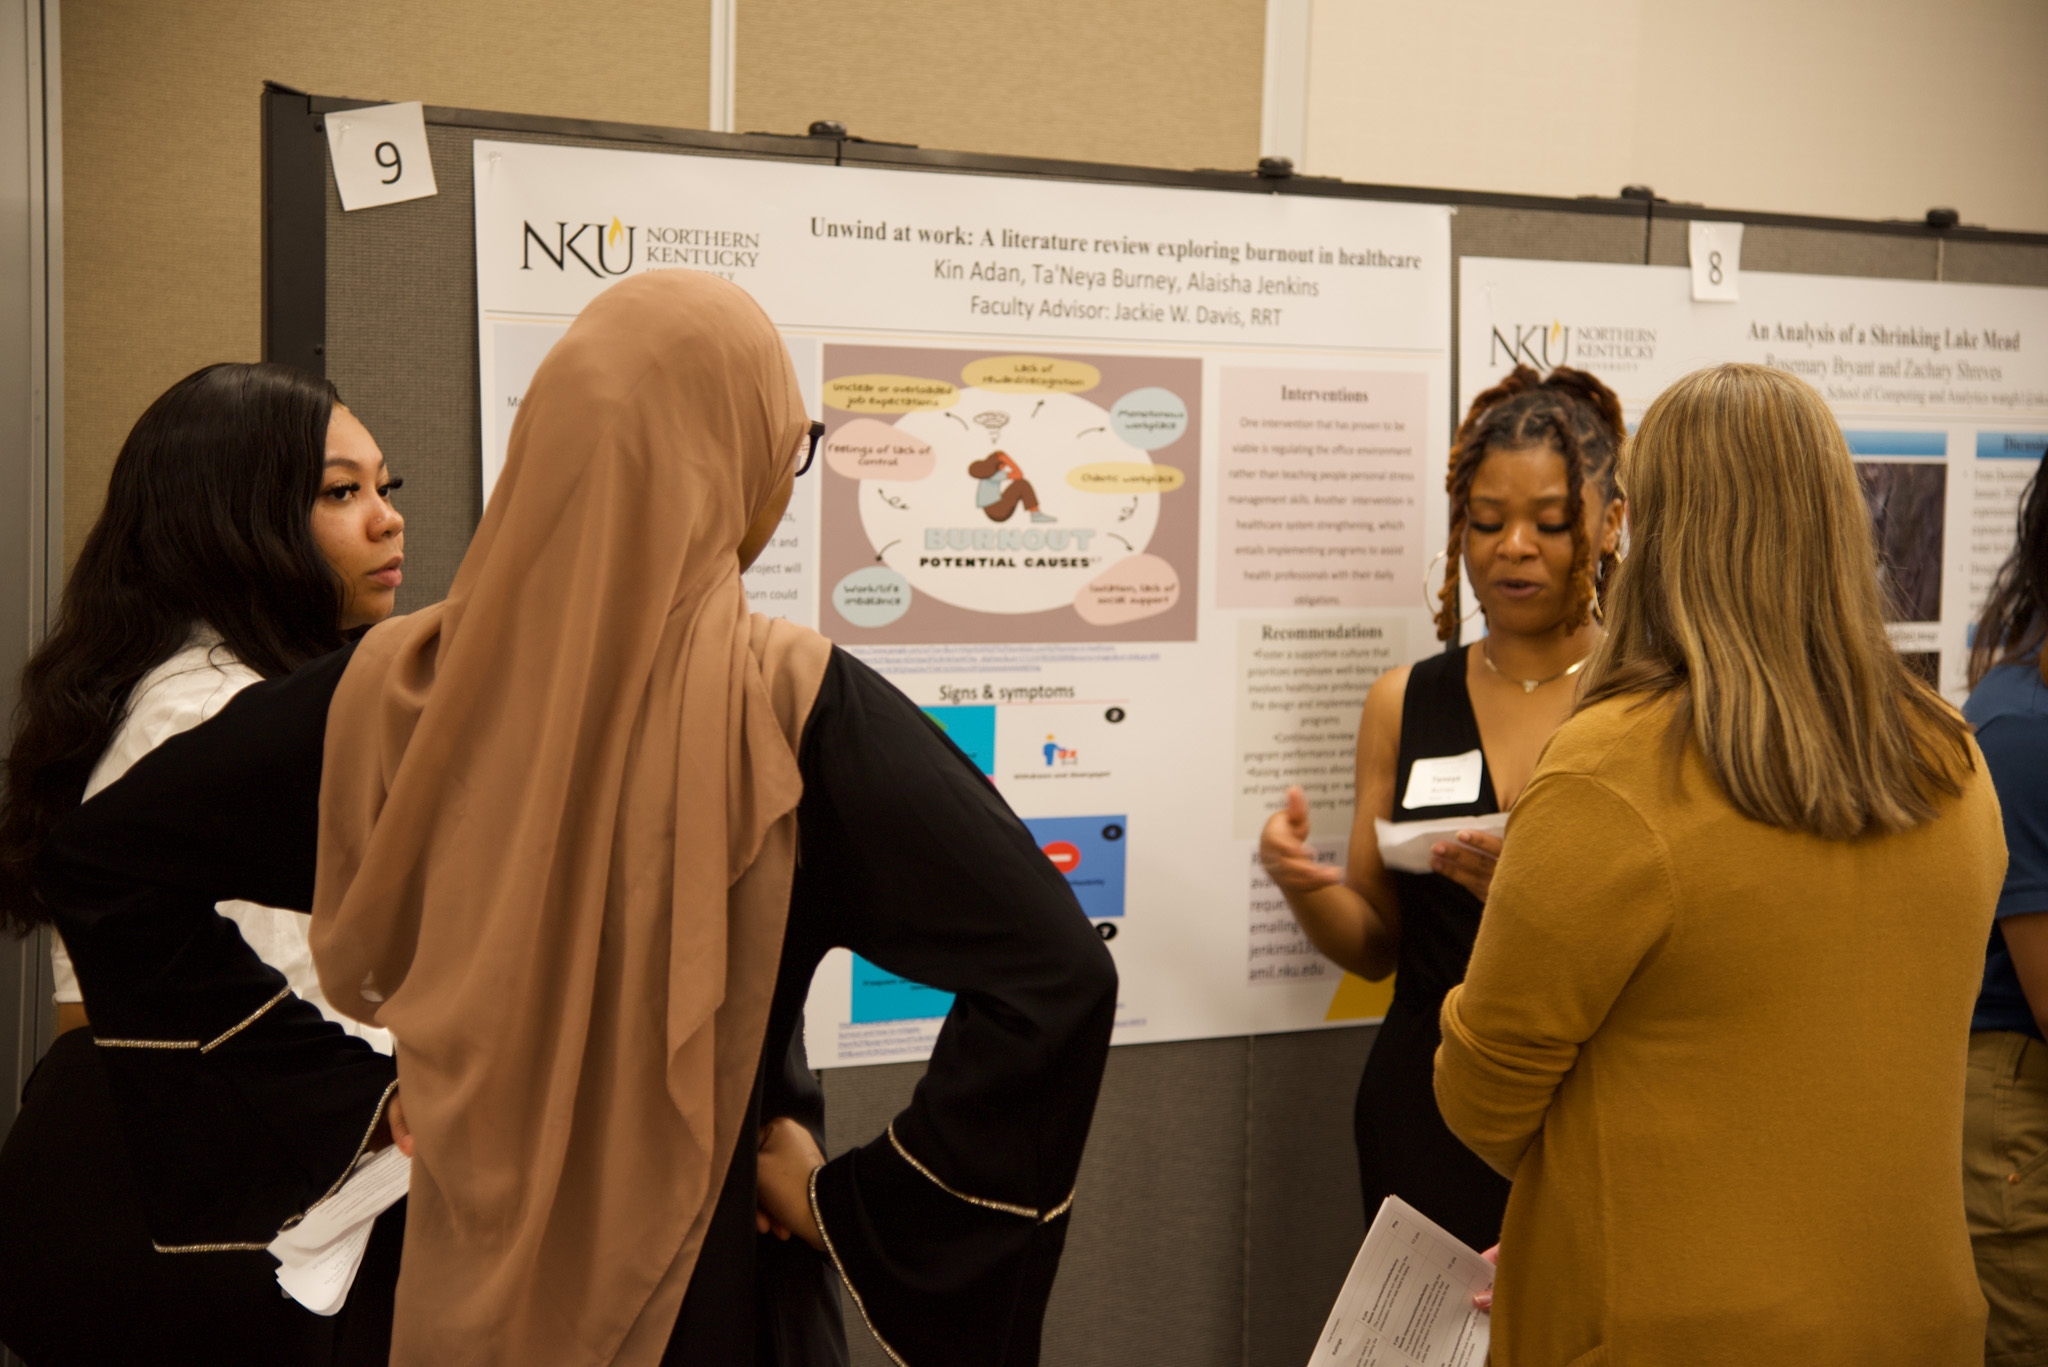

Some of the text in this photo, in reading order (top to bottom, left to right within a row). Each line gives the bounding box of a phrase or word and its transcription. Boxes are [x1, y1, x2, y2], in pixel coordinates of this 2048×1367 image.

[375, 141, 402, 184] 9
[520, 219, 637, 278] NKU
[646, 227, 760, 248] NORTHERN
[810, 216, 1422, 269] Unwind at work: A literature review exploring burnout in healthcare
[646, 247, 760, 267] KENTUCKY
[1709, 250, 1723, 285] 8
[934, 259, 1320, 297] Kin Adan, Ta'Neya Burney, Alaisha Jenkins
[971, 295, 1283, 328] Faculty Advisor: Jackie W. Davis, RRT
[1576, 326, 1656, 343] NORTHERN
[1748, 319, 2021, 352] An Analysis of a Shrinking Lake Mead
[1490, 324, 1570, 371] NKU
[1576, 343, 1656, 360] KENTUCKY
[1041, 364, 1055, 373] of
[1832, 355, 1875, 382] Bryant
[1879, 357, 1899, 378] and
[1903, 358, 1952, 384] Zachary
[1281, 385, 1368, 403] Interventions
[924, 528, 1096, 551] BURNOUT
[919, 557, 1017, 568] POTENTIAL
[1262, 623, 1383, 641] Recommendations
[939, 684, 1075, 705] Signs & symptoms
